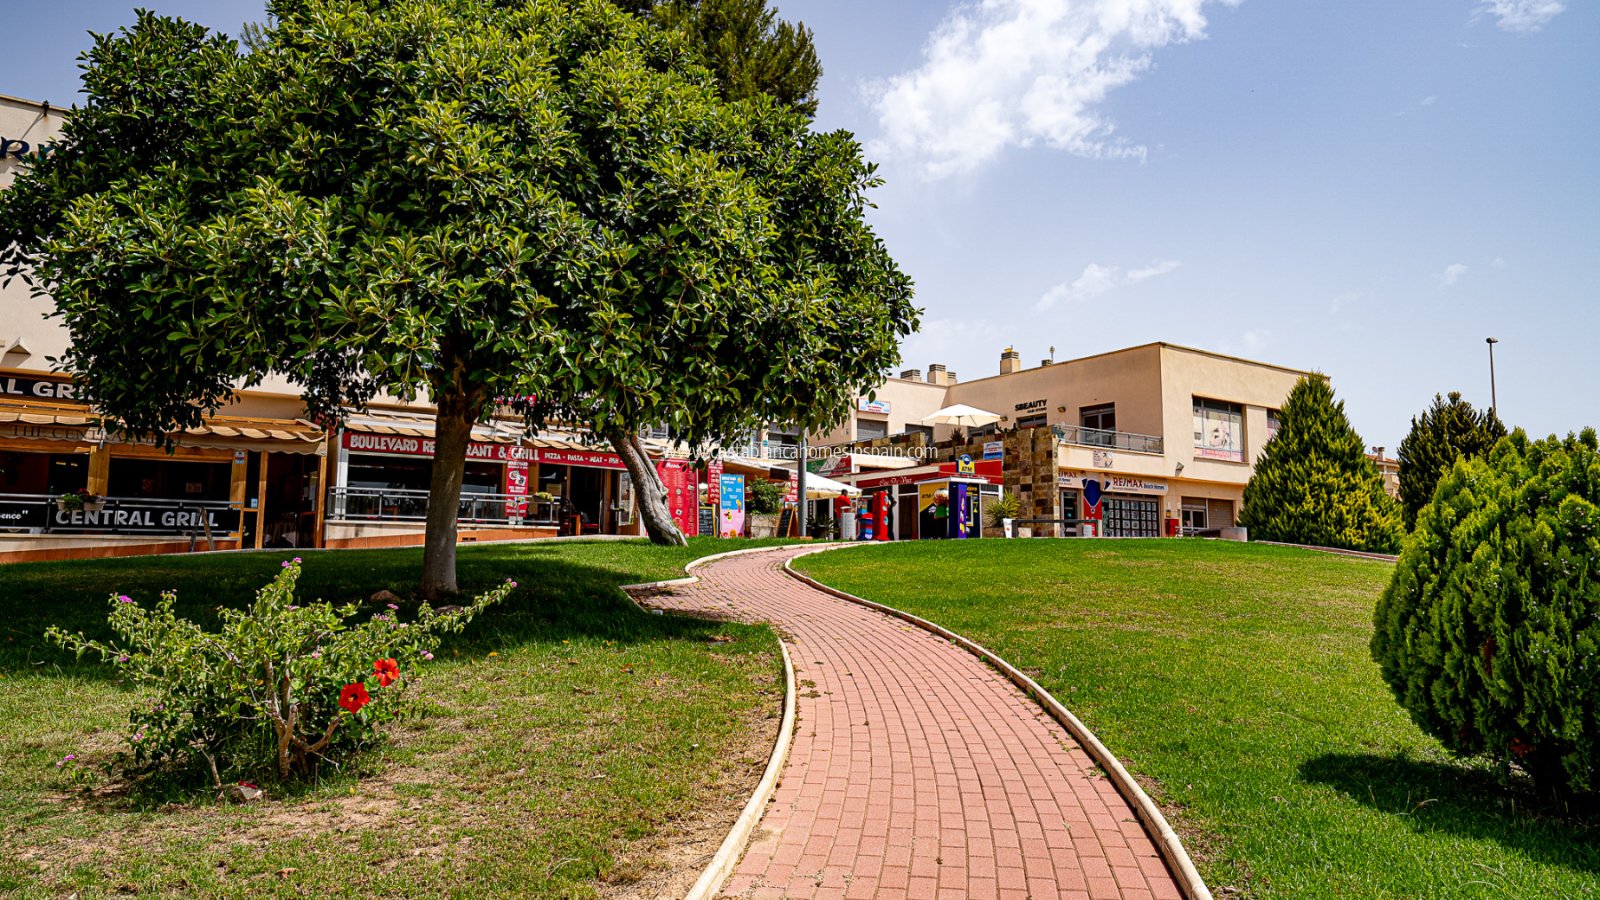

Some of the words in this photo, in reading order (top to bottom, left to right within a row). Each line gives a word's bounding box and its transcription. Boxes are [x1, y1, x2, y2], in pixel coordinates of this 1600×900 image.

[350, 435, 418, 451] BOULEVARD
[498, 446, 506, 459] &
[511, 447, 540, 461] GRILL
[544, 452, 561, 460] PIZZA
[567, 454, 584, 462] PASTA
[1113, 477, 1143, 488] RE/MAX
[56, 509, 155, 526] CENTRAL
